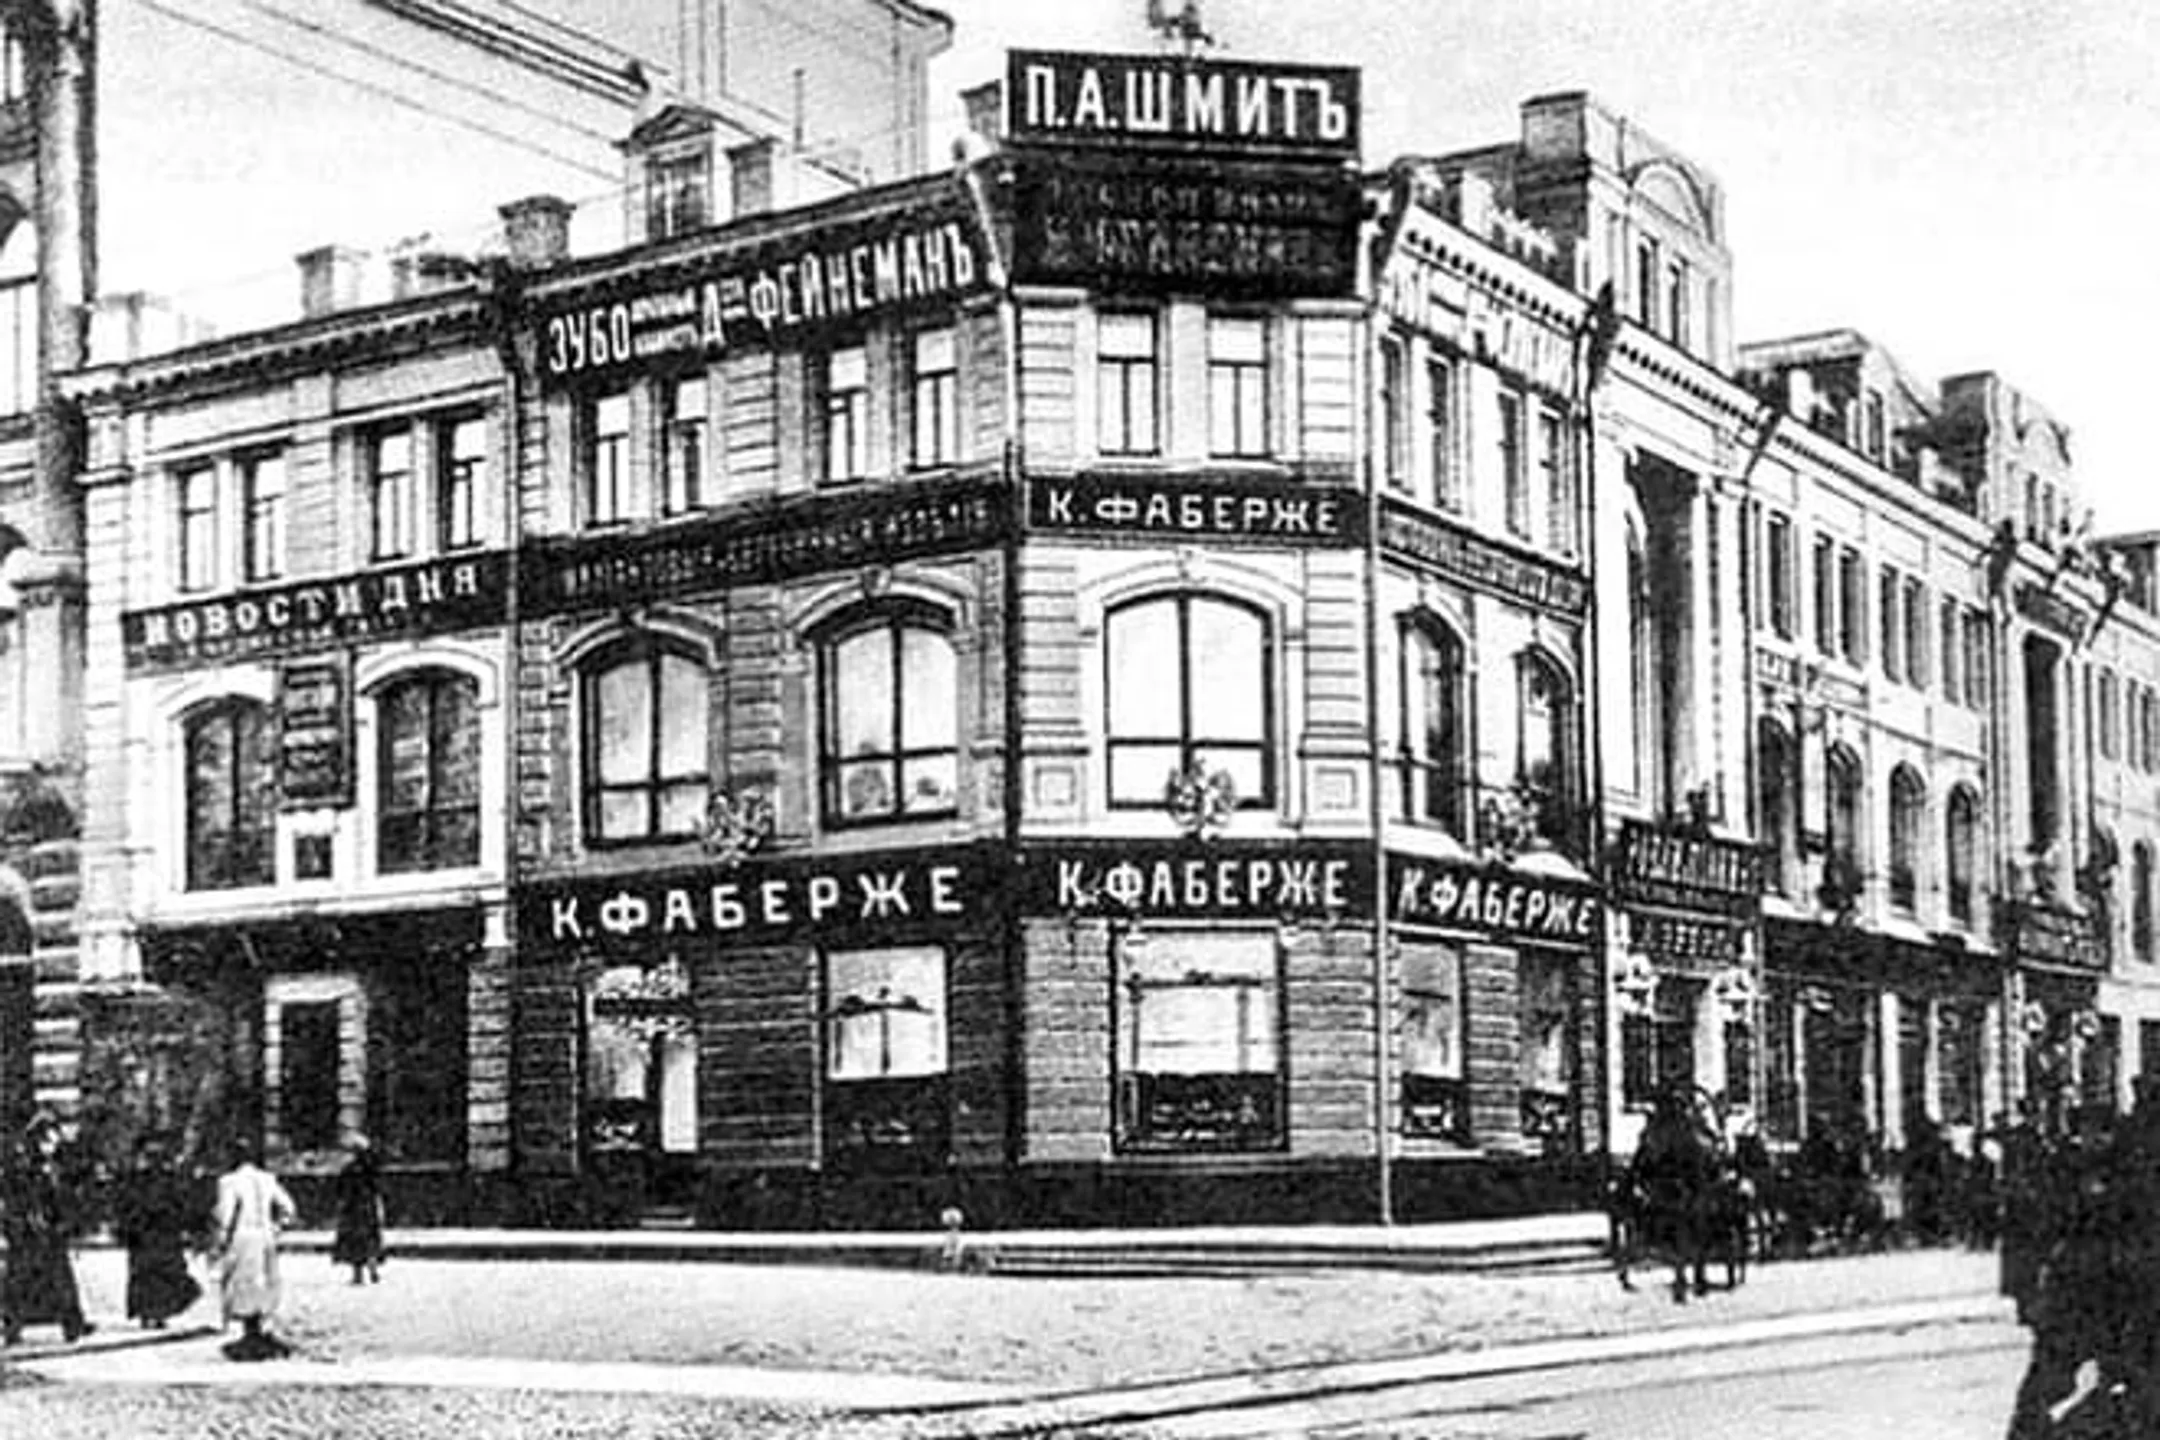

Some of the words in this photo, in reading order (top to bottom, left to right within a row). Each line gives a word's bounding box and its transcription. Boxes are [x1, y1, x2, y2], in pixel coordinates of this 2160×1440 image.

[1026, 64, 1347, 140] П.А.ШМИТЪ
[548, 302, 630, 373] ЗУБО
[748, 222, 975, 331] ФЕЙНЕМАНЪ
[142, 581, 364, 647] НОВОСТИ
[379, 563, 478, 612] ДНЯ
